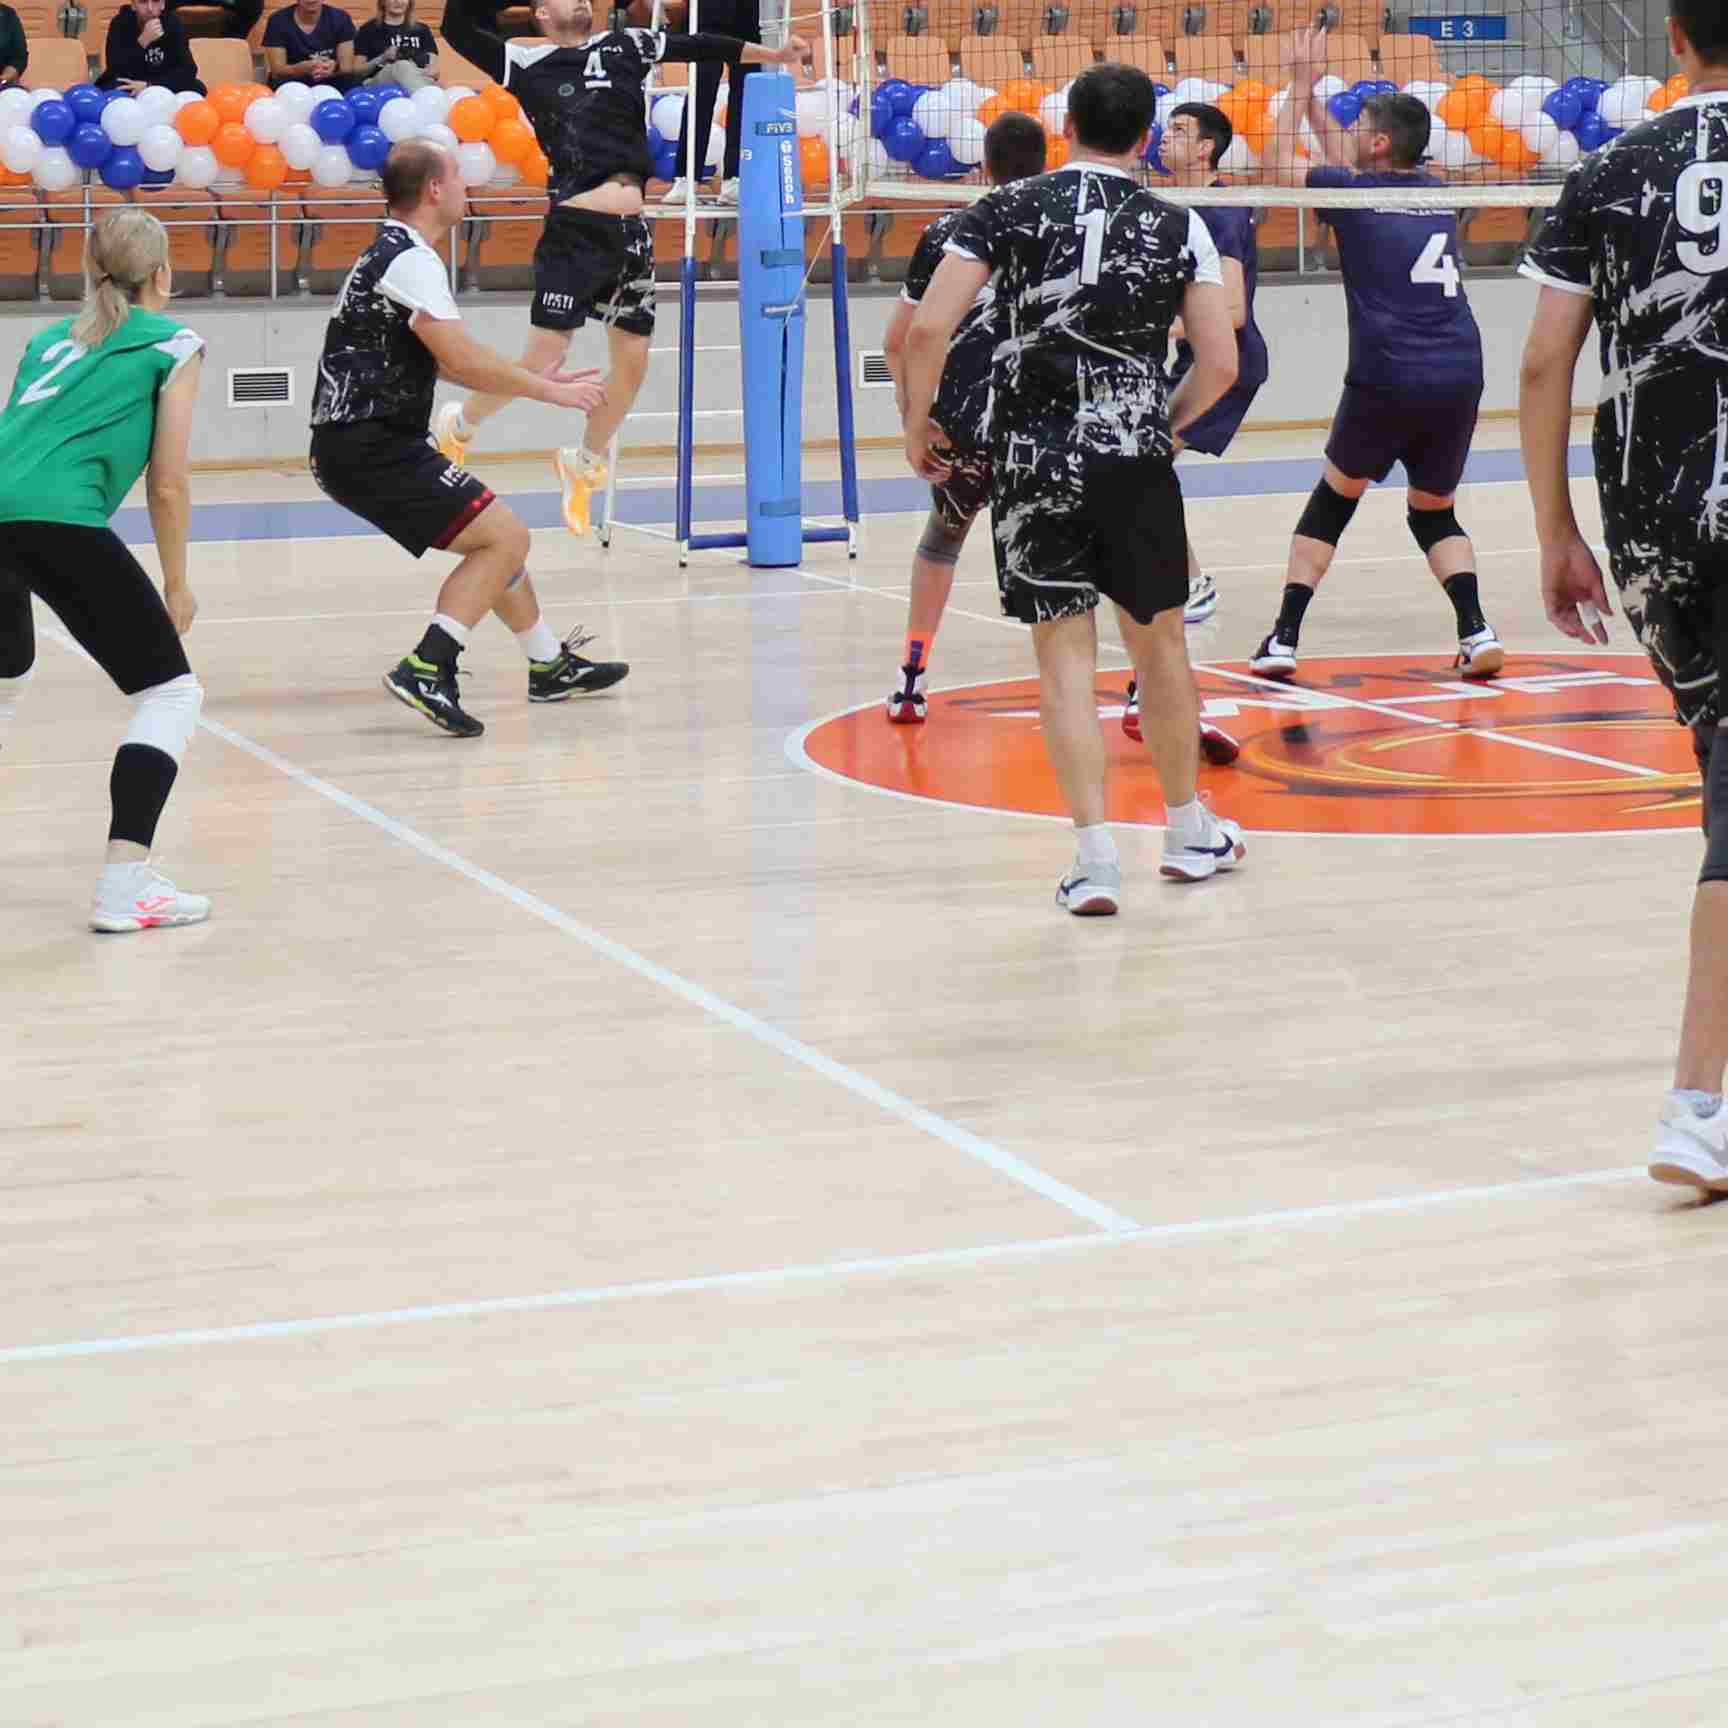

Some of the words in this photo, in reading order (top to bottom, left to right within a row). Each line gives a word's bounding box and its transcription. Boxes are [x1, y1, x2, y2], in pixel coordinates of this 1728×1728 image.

[1440, 21, 1453, 38] E
[1462, 20, 1475, 38] 3
[582, 49, 607, 78] 4
[1074, 208, 1107, 286] 1
[1409, 232, 1460, 298] 4
[16, 338, 88, 406] 2
